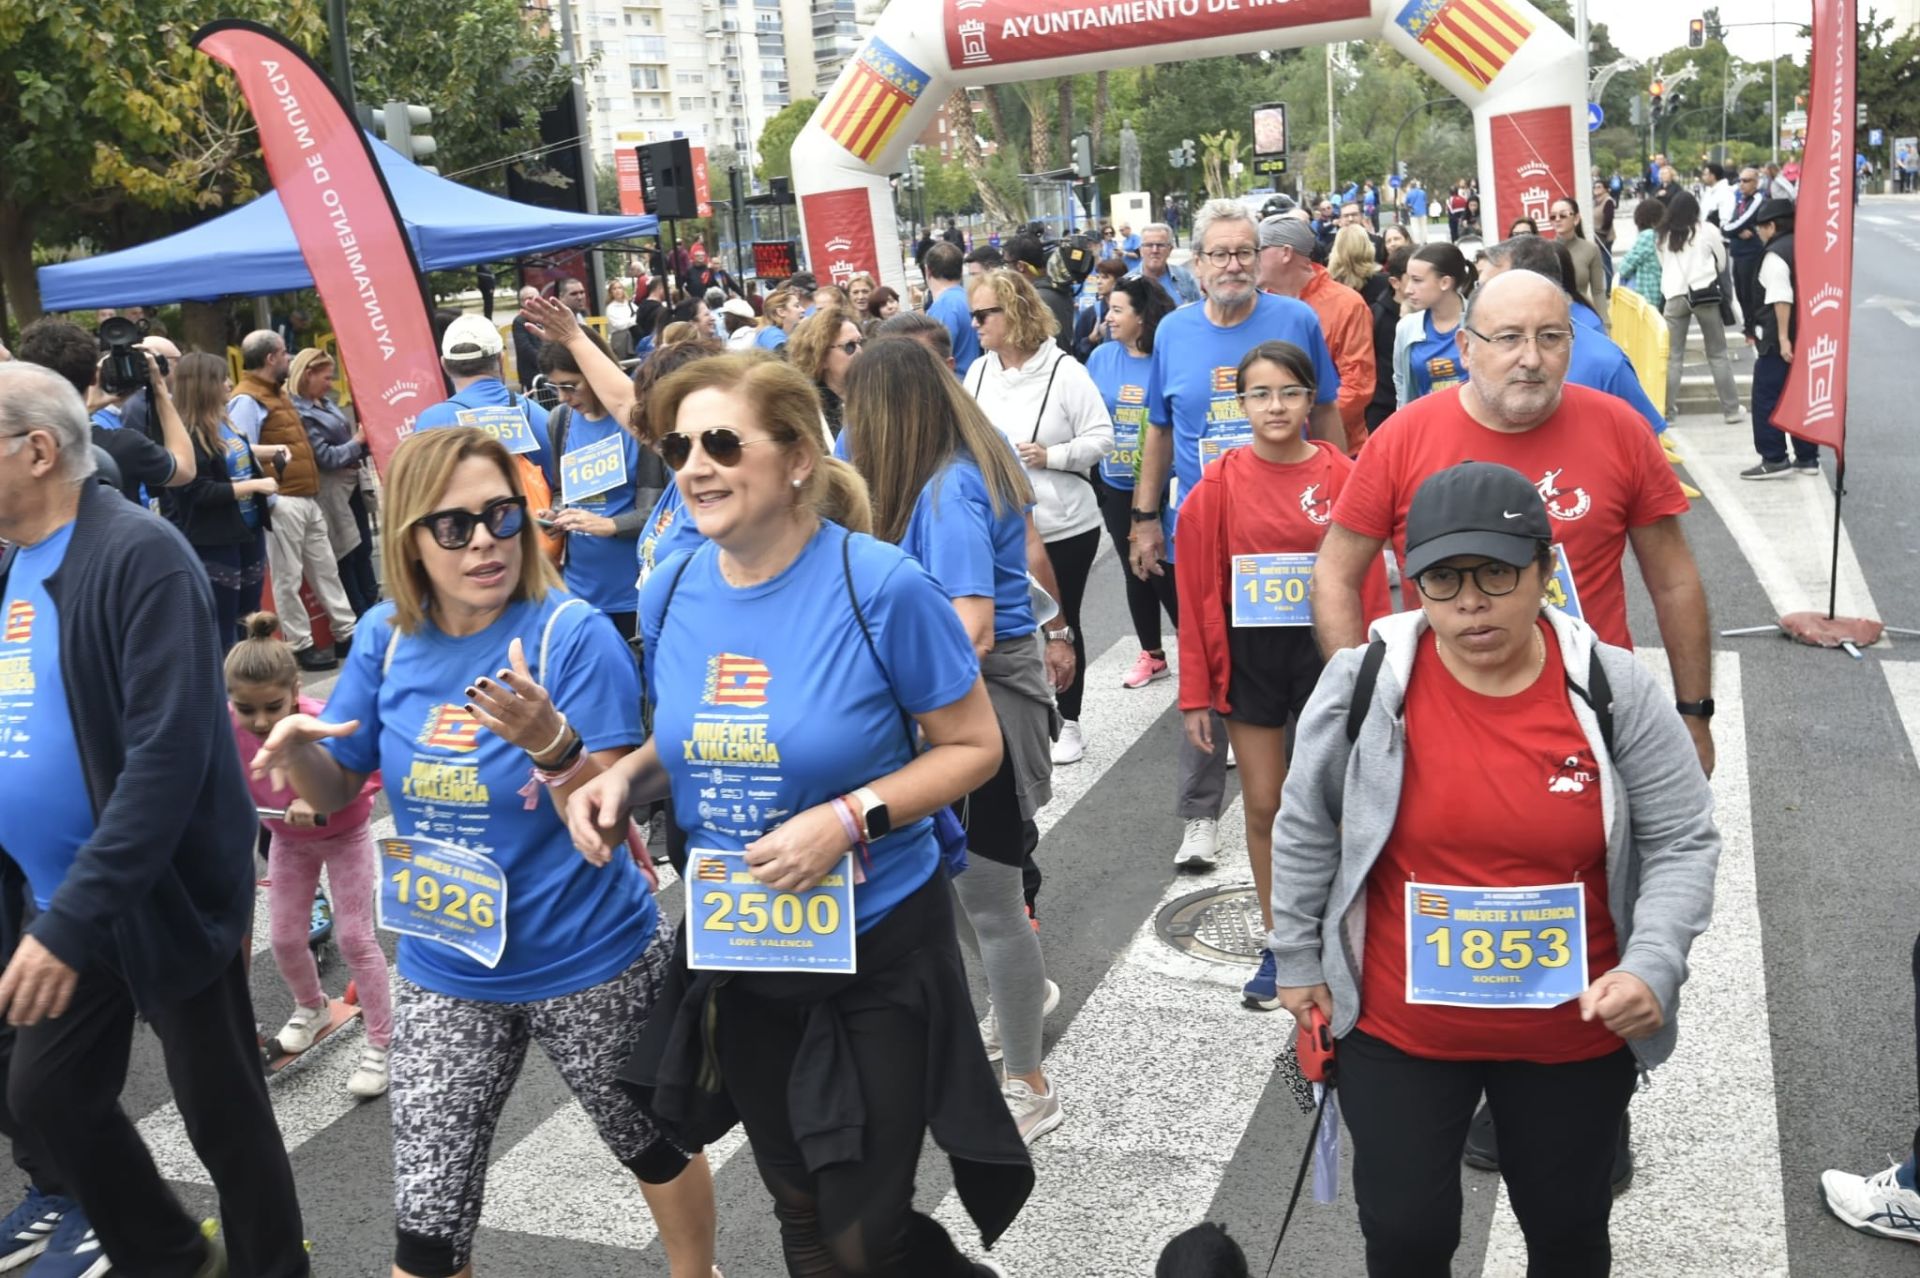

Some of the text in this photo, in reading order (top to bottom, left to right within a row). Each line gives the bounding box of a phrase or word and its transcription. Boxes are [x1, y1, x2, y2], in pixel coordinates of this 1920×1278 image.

[1001, 0, 1199, 39] AYUNTAMIENTO
[568, 453, 620, 485] 1608
[693, 719, 768, 744] MUÉVETE
[682, 740, 780, 763] X VALENCIA
[411, 761, 479, 785] MUÉVETE
[402, 776, 412, 794] X
[414, 779, 490, 803] VALENCIA
[391, 868, 495, 928] 1926
[702, 890, 841, 934] 2500
[1453, 906, 1576, 922] MUÉVETE X VALENCIA
[729, 937, 815, 948] LOVE VALENCIA
[1425, 926, 1571, 970] 1853
[1472, 975, 1522, 983] XOCHITL
